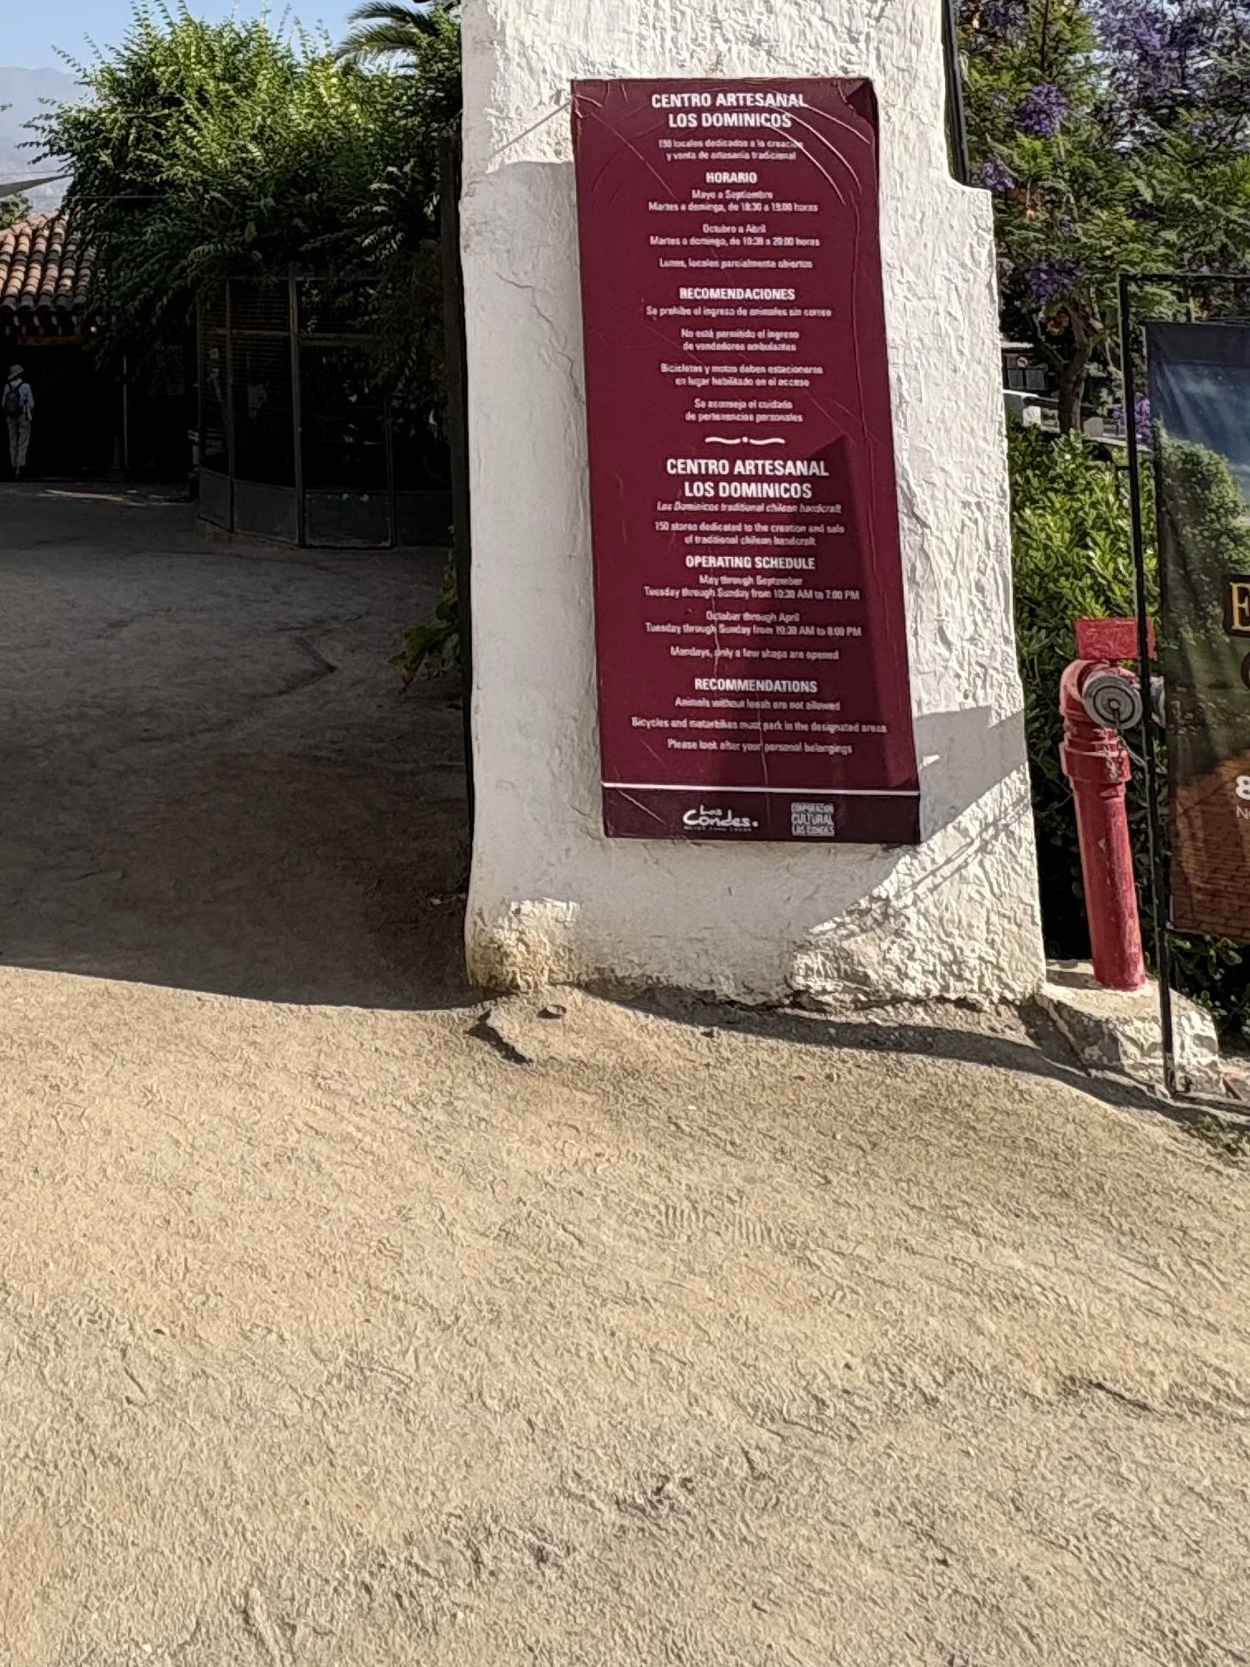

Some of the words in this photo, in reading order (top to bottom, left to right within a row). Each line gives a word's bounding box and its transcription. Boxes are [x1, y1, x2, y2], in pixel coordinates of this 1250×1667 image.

[652, 93, 711, 108] CENTRO
[716, 93, 806, 108] ARTESANAL
[669, 113, 697, 127] LOS
[702, 112, 791, 128] DOMINICOS
[673, 139, 703, 147] locales
[705, 139, 748, 147] dedicados
[666, 153, 671, 161] y
[698, 151, 709, 159] de
[752, 151, 796, 160] tradicional
[706, 172, 757, 183] HORARIO
[725, 190, 773, 200] Septiembre
[648, 202, 679, 211] Martes
[688, 202, 725, 213] domingo,
[728, 202, 738, 211] de
[794, 203, 818, 211] horas
[703, 224, 736, 233] Octubre
[746, 224, 766, 233] Abril
[650, 236, 680, 245] Martes
[690, 237, 728, 247] domingo,
[730, 237, 740, 245] de
[796, 237, 820, 246] horas
[659, 258, 686, 268] Lunes,
[689, 258, 719, 267] locales
[721, 259, 776, 269] parcialmente
[778, 259, 812, 268] abiertos
[680, 288, 795, 300] RECOMENDACIONES
[646, 306, 657, 315] Se
[693, 306, 701, 315] el
[703, 307, 735, 317] ingreso
[737, 307, 747, 316] de
[750, 307, 787, 316] animales
[681, 329, 693, 337] No
[716, 329, 755, 339] permitido
[758, 330, 765, 338] el
[767, 329, 799, 340] ingreso
[683, 342, 693, 350] de
[695, 342, 745, 350] vendedores
[747, 342, 796, 351] ambulantes
[661, 363, 702, 372] Bicicletas
[704, 366, 709, 374] y
[712, 365, 737, 373] motos
[740, 365, 766, 373] deben
[768, 366, 823, 374] estacionarse
[688, 376, 709, 387] lugar
[712, 377, 753, 385] habilitado
[768, 377, 776, 386] el
[694, 398, 706, 408] Se
[708, 401, 746, 410] aconseja
[748, 400, 756, 408] el
[758, 400, 792, 409] cuidado
[685, 412, 695, 420] de
[698, 412, 753, 422] pertenencias
[756, 413, 803, 423] personales
[667, 459, 729, 474] CENTRO
[733, 460, 829, 476] ARTESANAL
[684, 482, 714, 497] LOS
[719, 482, 812, 498] DOMINICOS
[657, 501, 672, 511] Los
[674, 501, 719, 511] Dominicos
[721, 503, 764, 512] traditional
[766, 503, 797, 512] chilean
[700, 522, 742, 532] dedicated
[744, 524, 752, 532] to
[755, 523, 768, 532] the
[808, 524, 824, 533] and
[827, 524, 844, 533] sale
[684, 534, 693, 544] of
[695, 535, 738, 544] traditional
[740, 536, 771, 545] chilean
[685, 555, 751, 568] OPERATING
[755, 557, 815, 569] SCHEDULE
[699, 575, 719, 585] May
[721, 575, 754, 587] through
[756, 575, 803, 587] September
[644, 586, 679, 598] Tuesday
[682, 588, 715, 599] through
[717, 588, 749, 599] Sunday
[751, 588, 771, 598] from
[797, 589, 813, 598] AM
[814, 591, 823, 599] to
[845, 590, 859, 600] PM
[706, 611, 740, 623] October
[743, 612, 777, 623] through
[779, 612, 799, 623] April
[646, 622, 681, 634] Tuesday
[683, 624, 717, 637] through
[719, 623, 750, 635] Sunday
[753, 624, 773, 634] from
[799, 626, 814, 635] AM
[817, 627, 825, 636] to
[847, 627, 861, 636] PM
[671, 646, 712, 658] Mondays,
[714, 649, 733, 659] only
[743, 648, 759, 657] few
[790, 651, 804, 659] are
[806, 650, 839, 660] opened
[695, 678, 817, 692] RECOMMENDATIONS
[675, 697, 710, 707] Animals
[712, 698, 745, 708] without
[790, 701, 804, 709] not
[806, 701, 840, 711] allowed
[632, 717, 669, 729] Bicycles
[671, 718, 687, 728] and
[689, 719, 737, 729] motorbikes
[740, 719, 761, 731] must
[763, 720, 782, 732] park
[785, 721, 793, 730] in
[795, 721, 809, 731] the
[811, 722, 859, 734] designated
[862, 725, 886, 733] areas
[667, 739, 697, 749] Please
[699, 740, 717, 750] look
[720, 740, 740, 750] after
[743, 738, 761, 752] your
[764, 742, 802, 752] personal
[804, 742, 852, 755] belongings
[791, 814, 834, 824] CULTURAL
